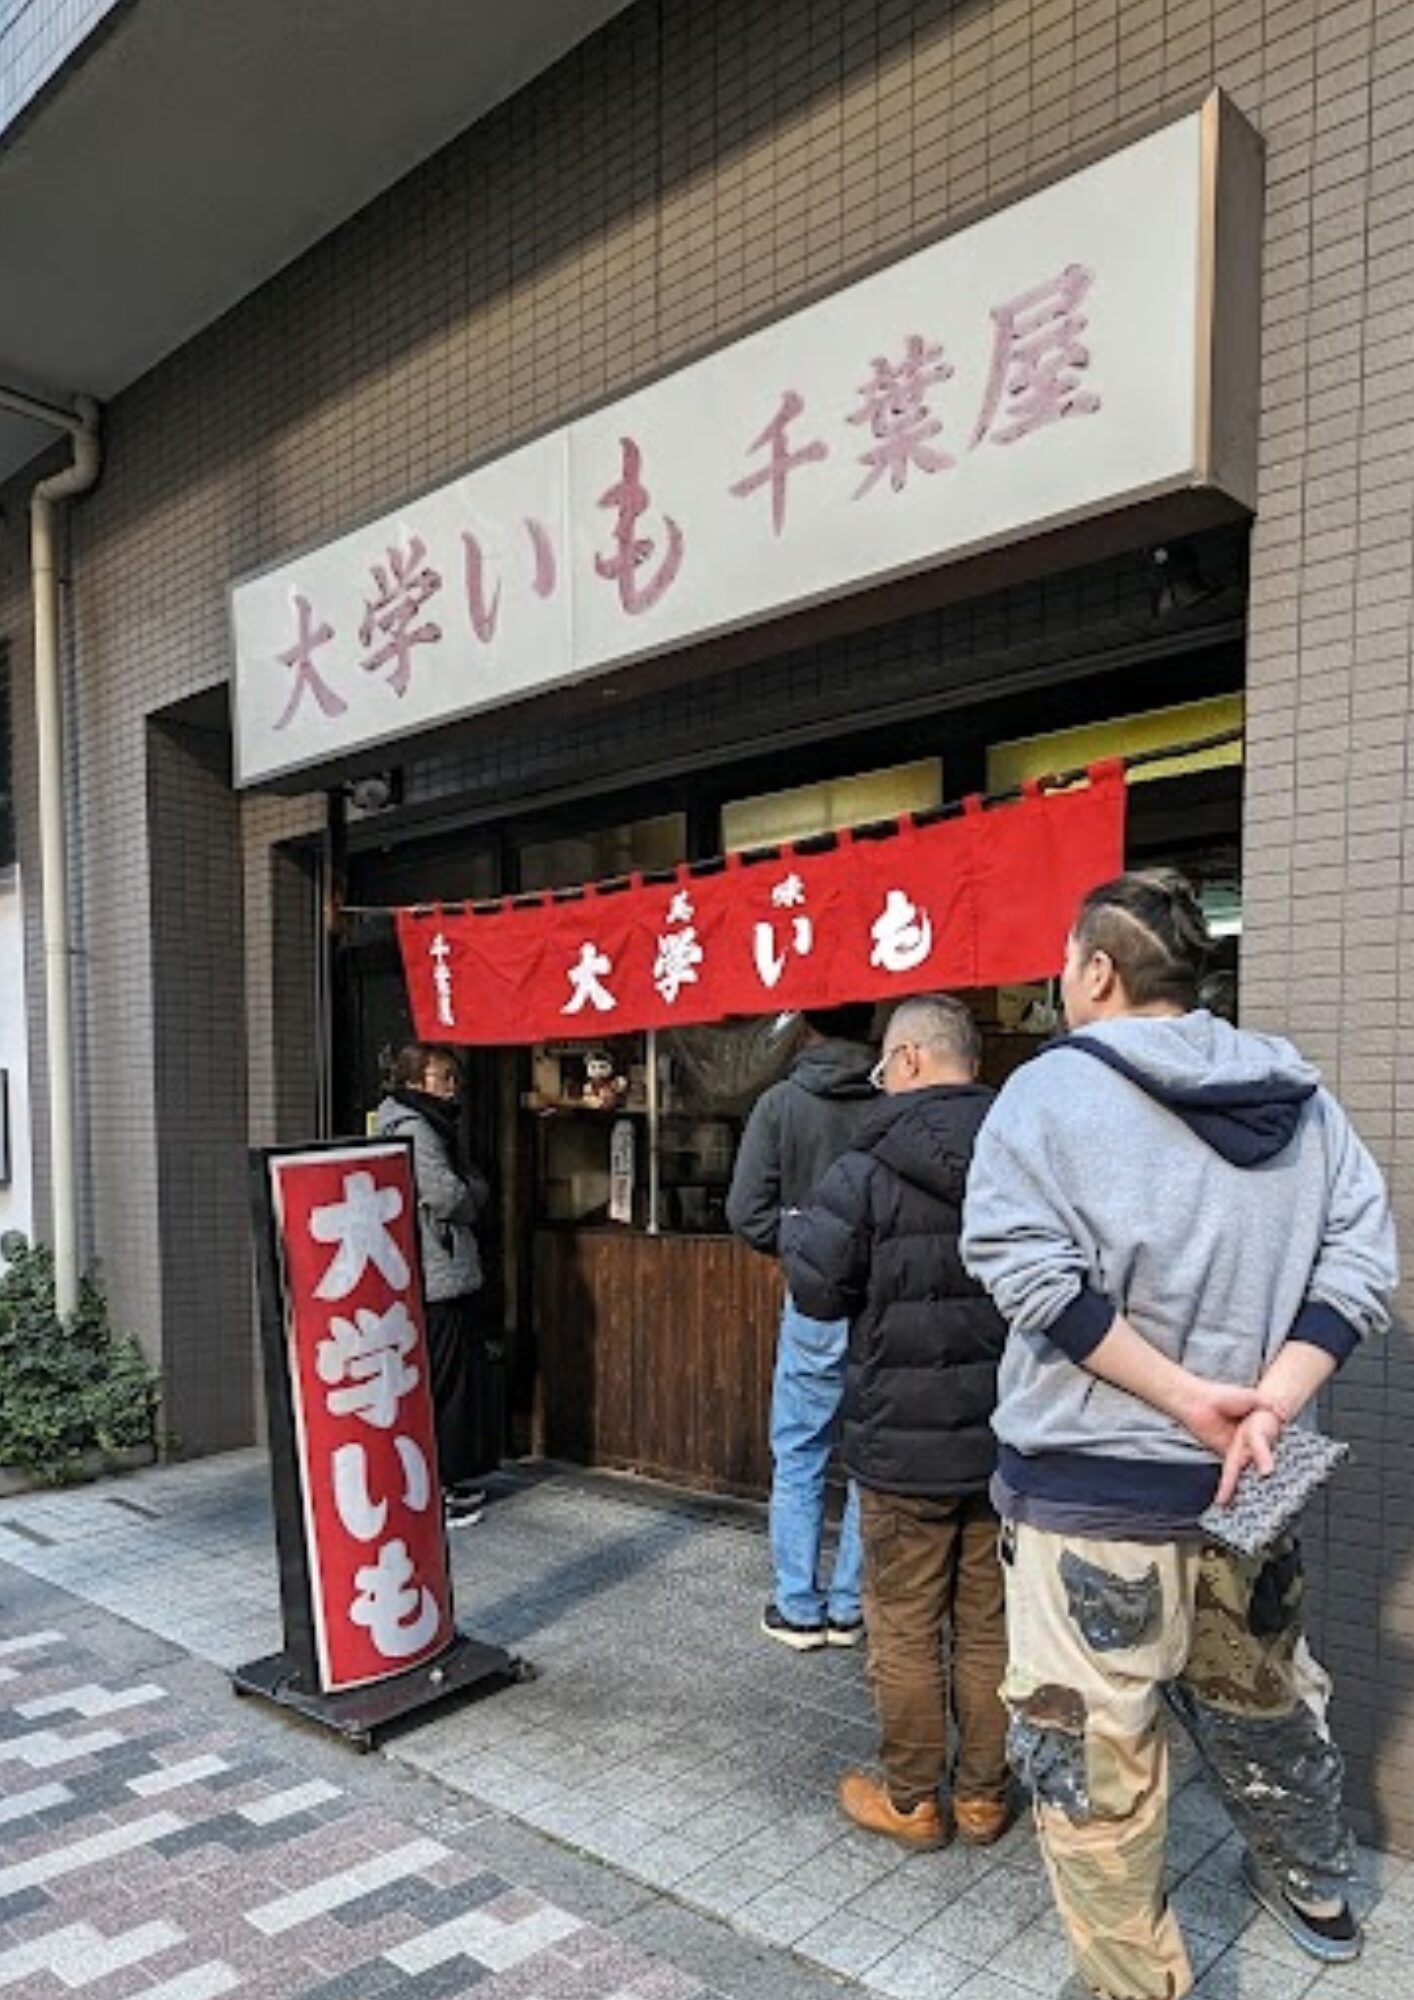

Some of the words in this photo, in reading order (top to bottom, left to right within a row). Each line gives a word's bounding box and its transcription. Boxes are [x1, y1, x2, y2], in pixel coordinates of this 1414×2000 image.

[274, 437, 684, 731] 大学いも
[731, 264, 1101, 535] 千葉屋
[562, 890, 932, 1013] 大学いも
[309, 1171, 439, 1657] 大学いも
